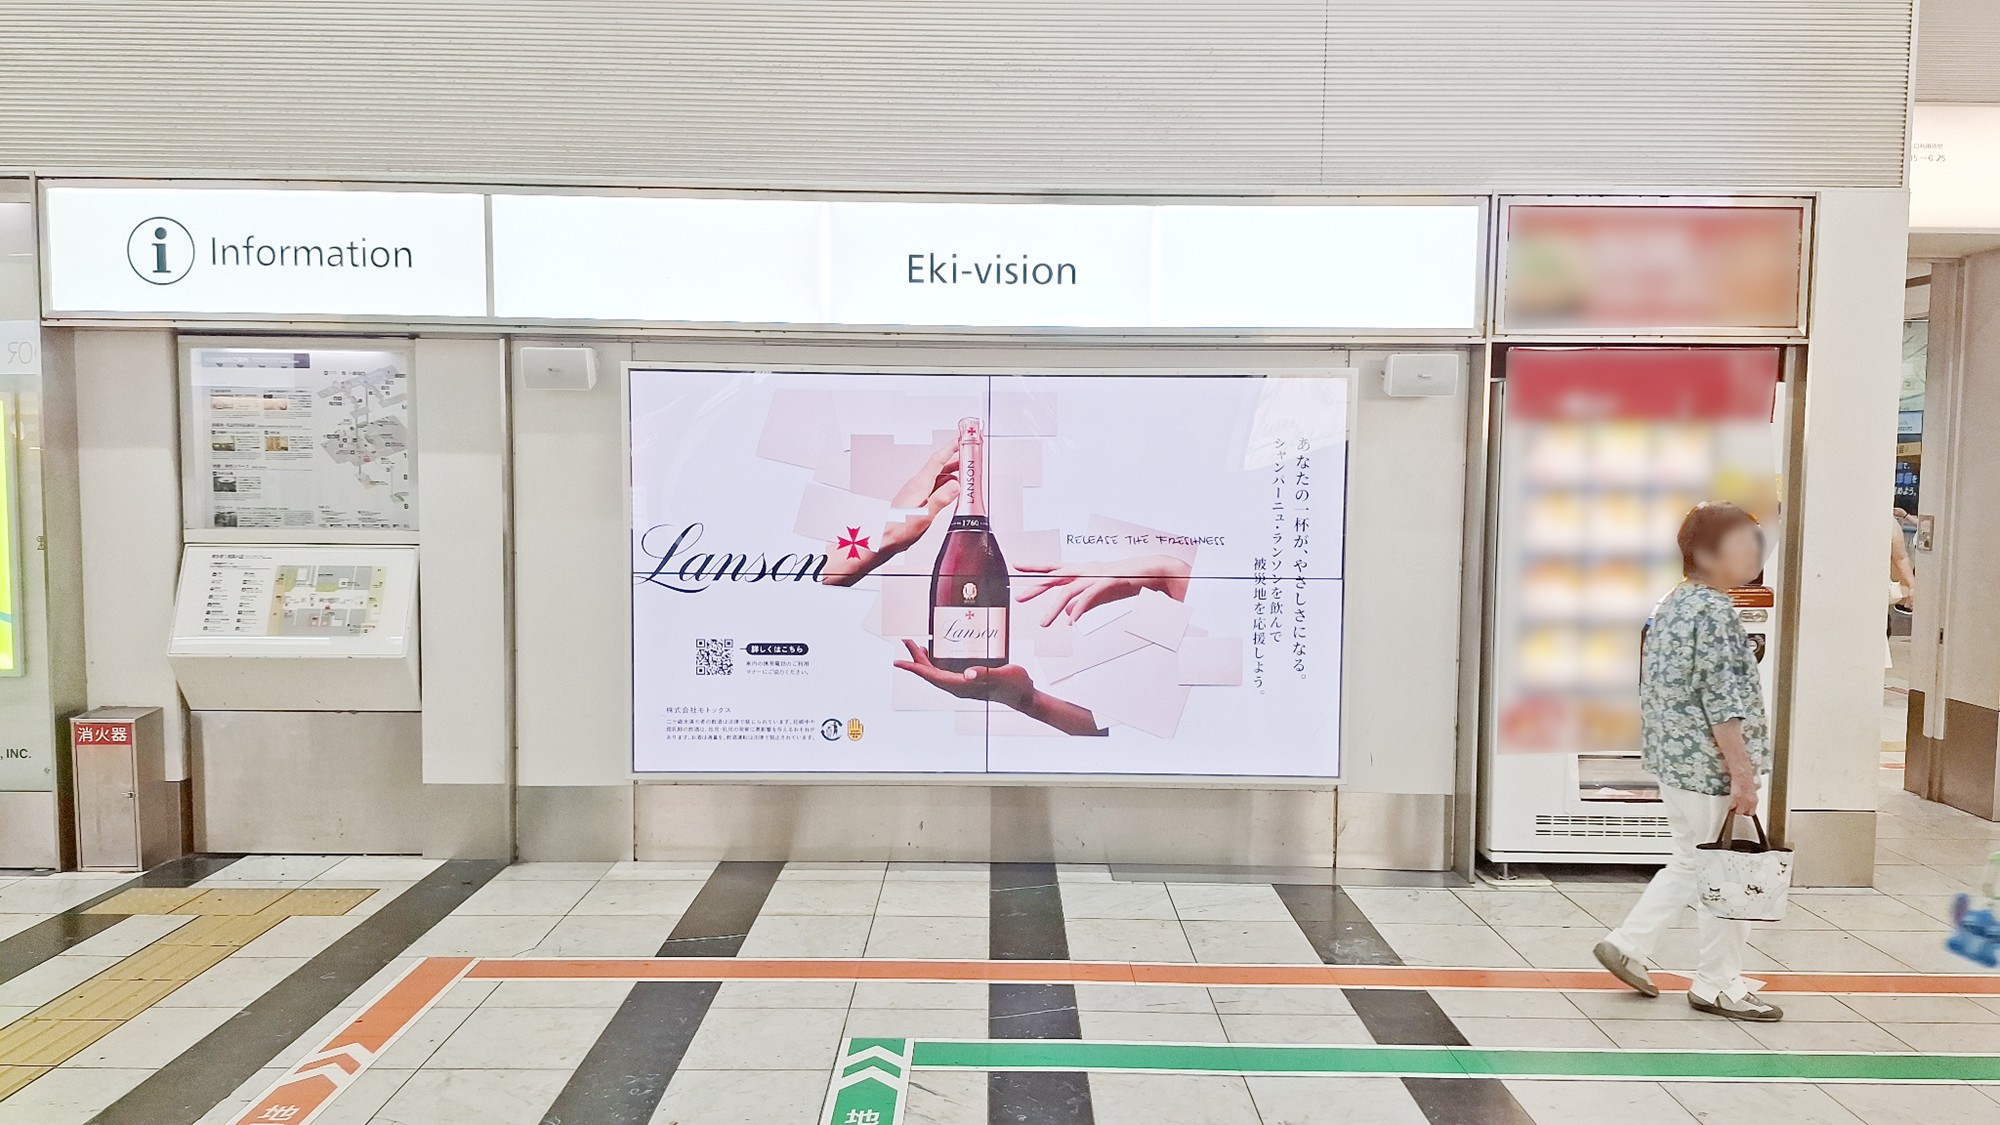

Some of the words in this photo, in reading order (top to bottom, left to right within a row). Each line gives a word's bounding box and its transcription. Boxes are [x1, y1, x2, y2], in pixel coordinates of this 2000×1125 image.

[211, 236, 413, 268] Information
[908, 253, 1076, 286] Eki-vision
[967, 460, 975, 504] LANSON
[1066, 534, 1119, 545] RELEASE
[1124, 534, 1149, 544] THE
[1156, 535, 1226, 546] FRESHNESS
[1270, 438, 1286, 643] シャンパーニュ・ランソンを飲んで
[634, 522, 829, 594] Lanson
[1292, 437, 1311, 680] あなたの一杯が、やさしさになる。
[942, 619, 999, 643] Lanson
[1253, 557, 1267, 695] 被災地を応援しよう。
[751, 645, 804, 654] 詳しくはこちら
[666, 706, 732, 714] 株式会社モトックス
[78, 727, 128, 742] 消火器
[6, 748, 32, 759] INC.
[257, 1104, 301, 1125] 地
[845, 1109, 880, 1125] 地
